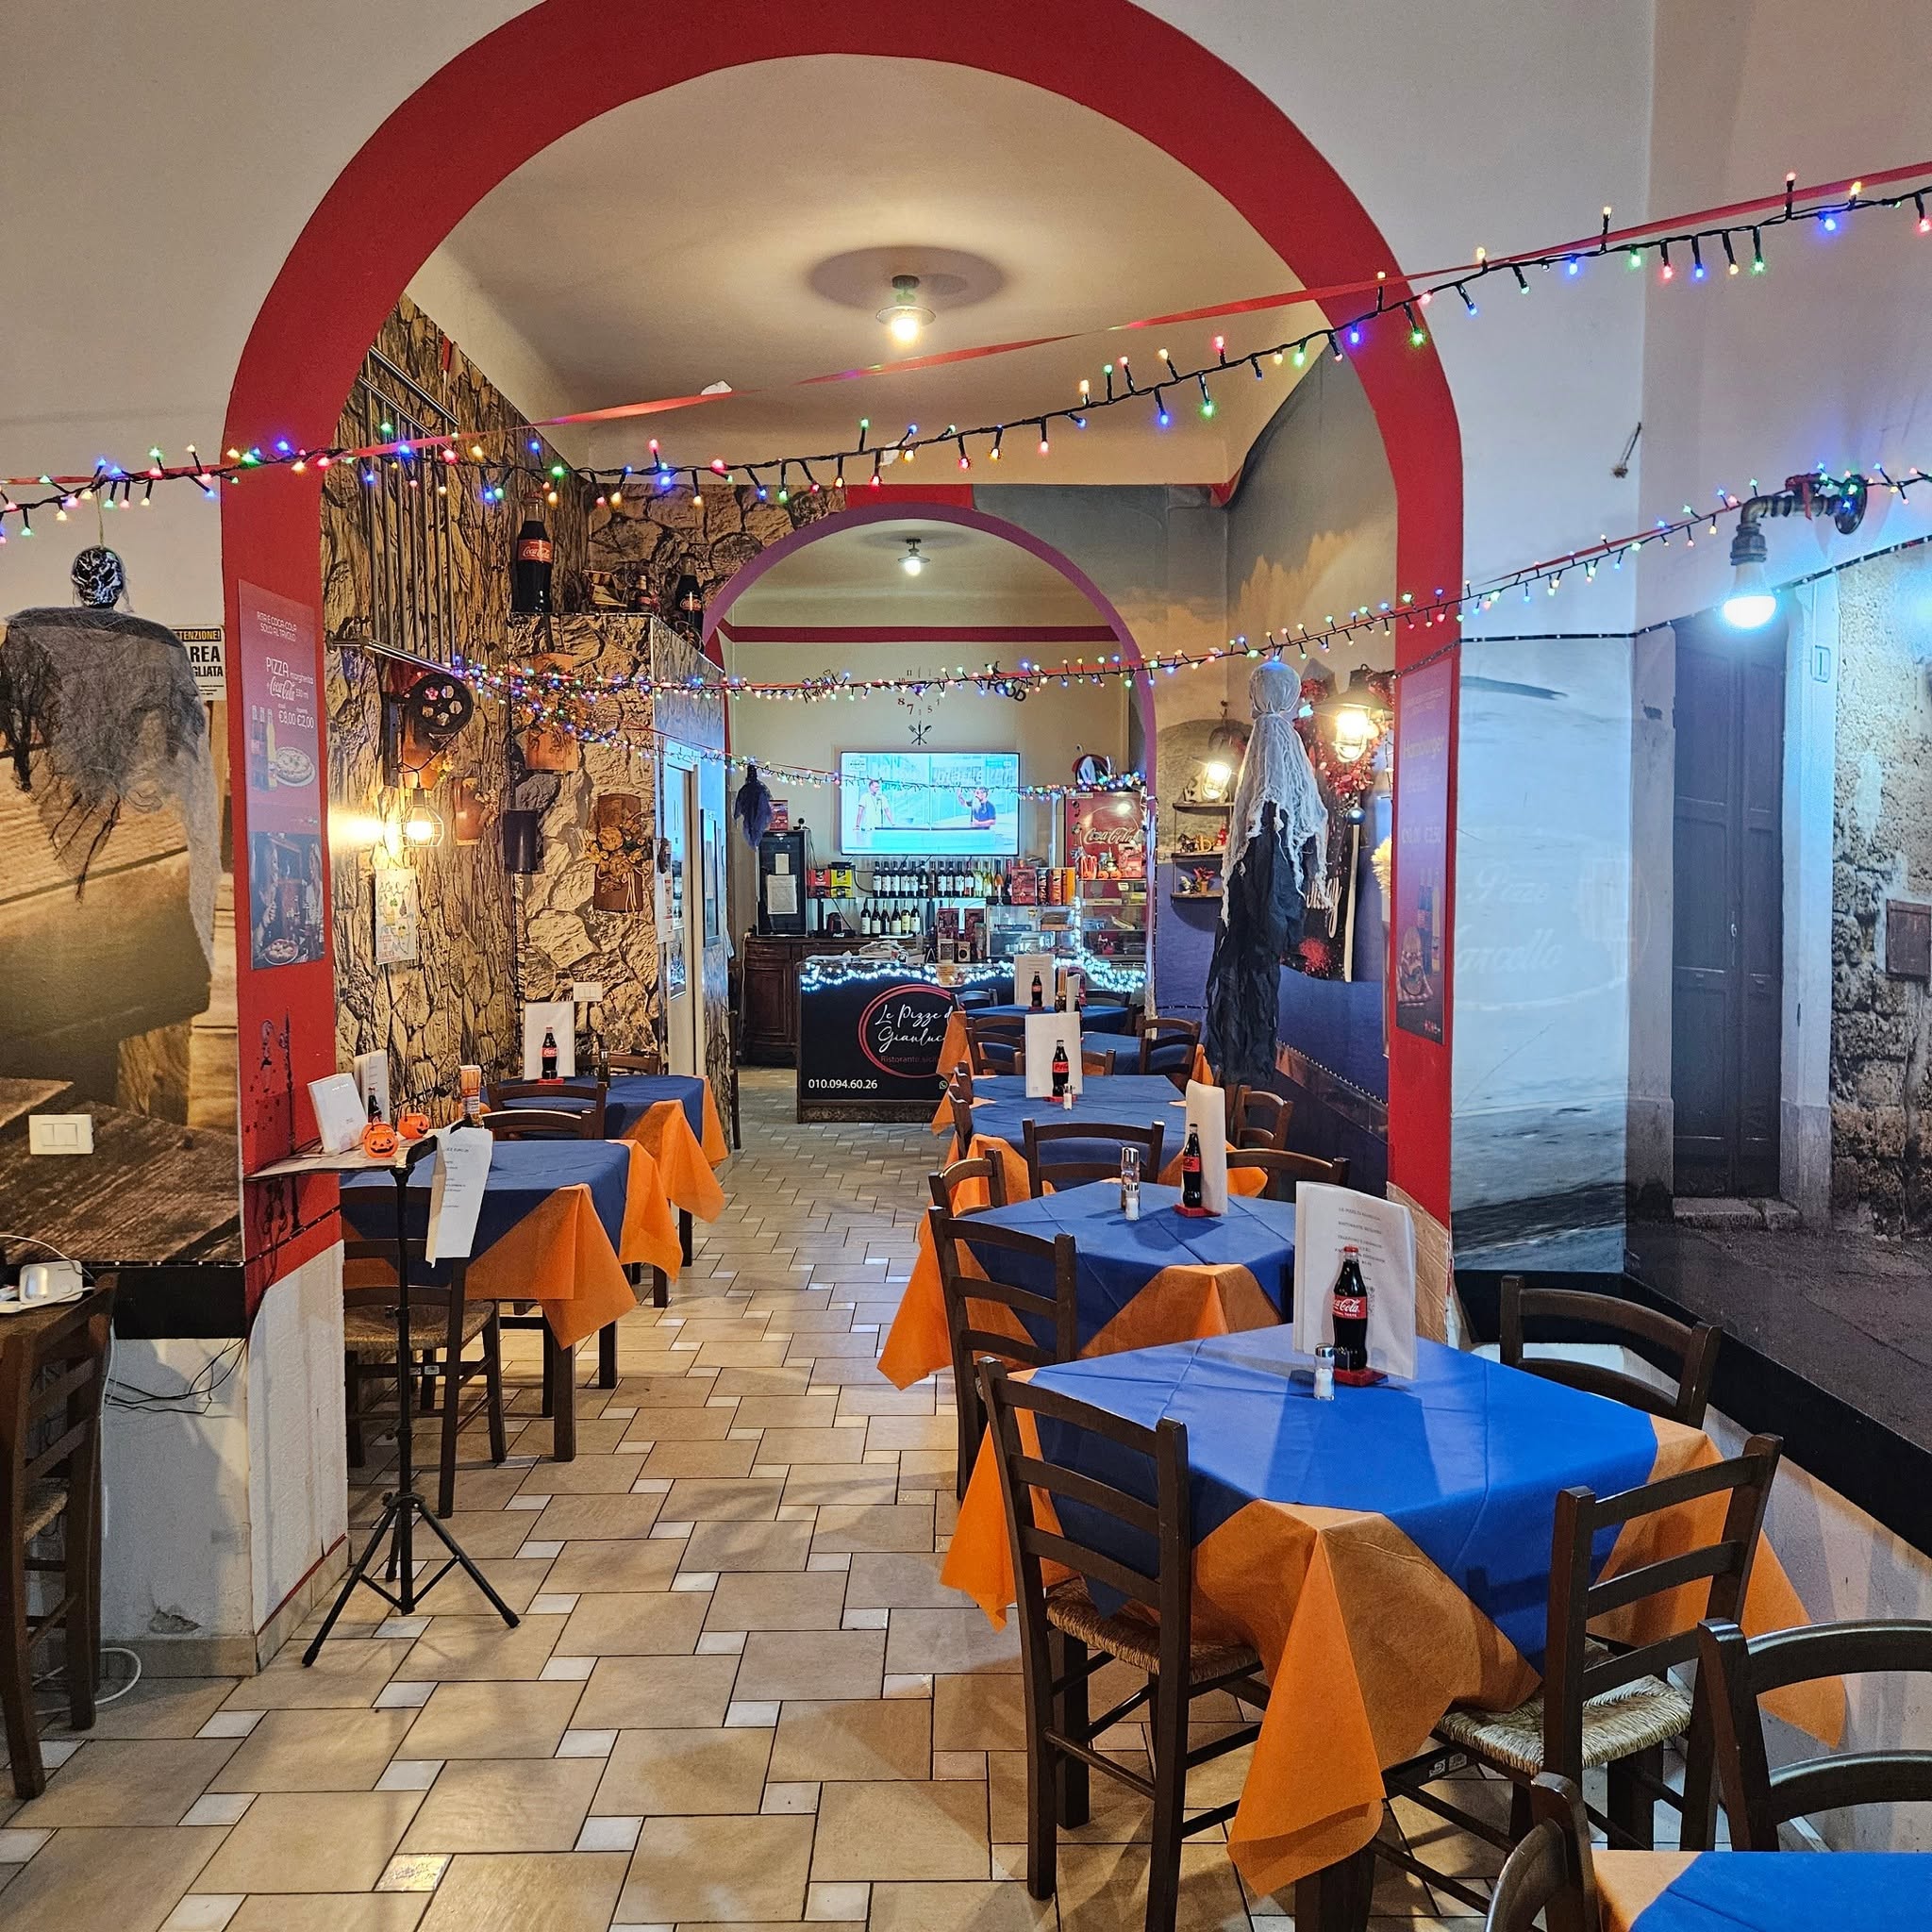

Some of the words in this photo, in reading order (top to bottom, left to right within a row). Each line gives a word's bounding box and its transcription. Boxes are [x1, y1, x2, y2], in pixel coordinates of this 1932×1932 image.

[189, 645, 222, 663] REA
[266, 656, 290, 677] PIZZA
[907, 703, 914, 716] 7
[874, 1004, 895, 1025] Le
[897, 1003, 942, 1028] Pizze
[808, 1079, 878, 1091] 010.094.60.26
